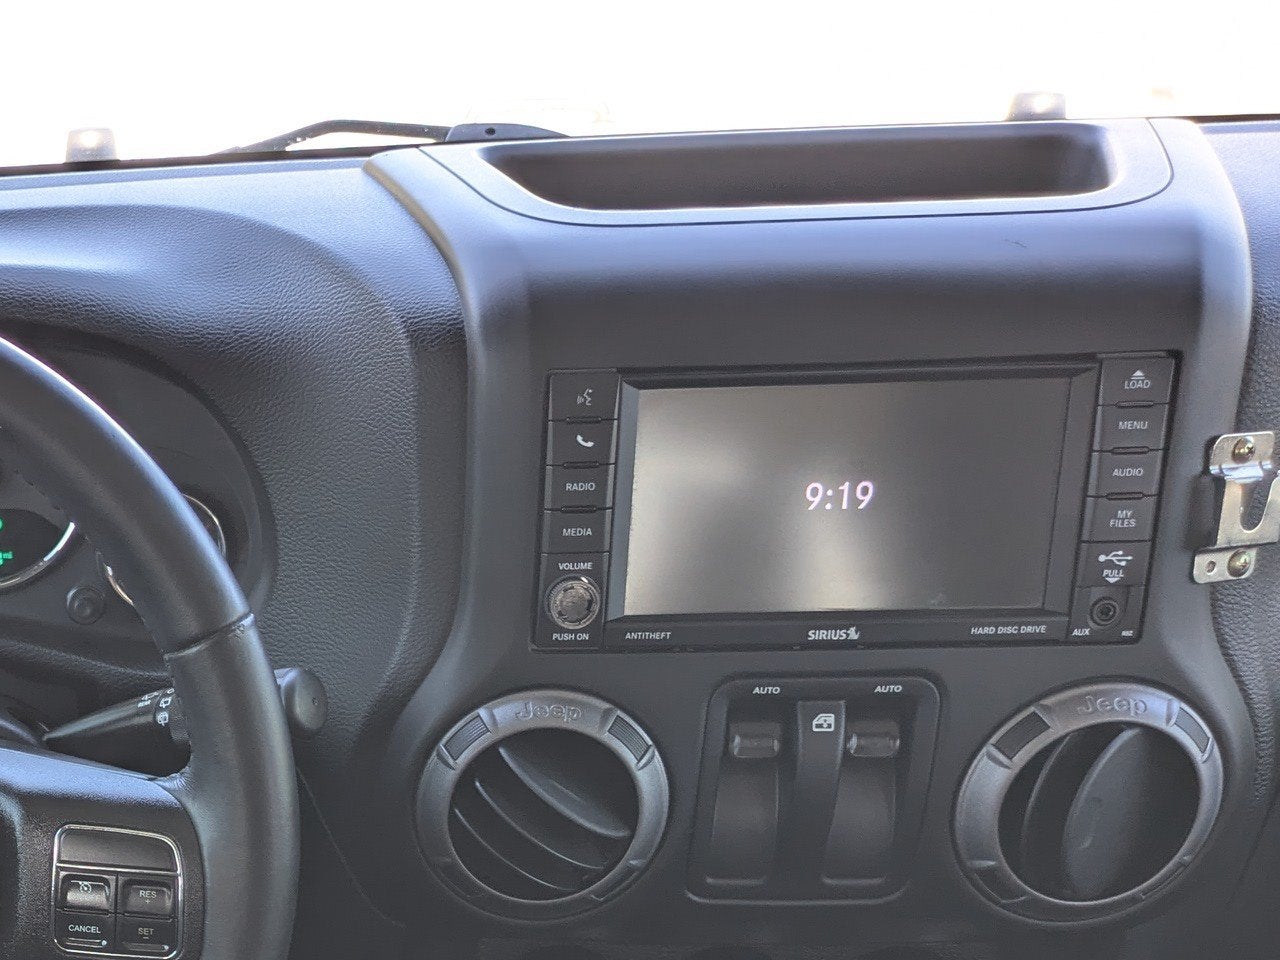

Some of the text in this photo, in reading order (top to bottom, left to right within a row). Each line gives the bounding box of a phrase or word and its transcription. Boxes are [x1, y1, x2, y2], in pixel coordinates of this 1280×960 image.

[1124, 379, 1150, 389] LOAD
[1118, 421, 1148, 430] MENU
[1112, 468, 1144, 477] AUDIO
[565, 483, 596, 491] RADIO
[805, 480, 875, 511] 9:19
[1118, 510, 1132, 519] MY
[1110, 518, 1136, 528] FILES
[562, 528, 592, 537] MEDIA
[558, 561, 593, 571] VOLUME
[1102, 569, 1124, 578] PULL
[970, 625, 1047, 635] HARD DISC DRIVE
[1072, 628, 1090, 636] AUX
[552, 633, 589, 641] PUSH ON
[625, 631, 671, 640] ANTITHEFT
[807, 629, 847, 641] SIRIUS
[752, 686, 780, 694] AUTO
[874, 685, 902, 693] AUTO
[1078, 694, 1148, 717] Jeep
[516, 701, 582, 723] Jeep
[139, 890, 156, 898] RES
[68, 924, 101, 934] CANCEL
[138, 927, 154, 935] SET
